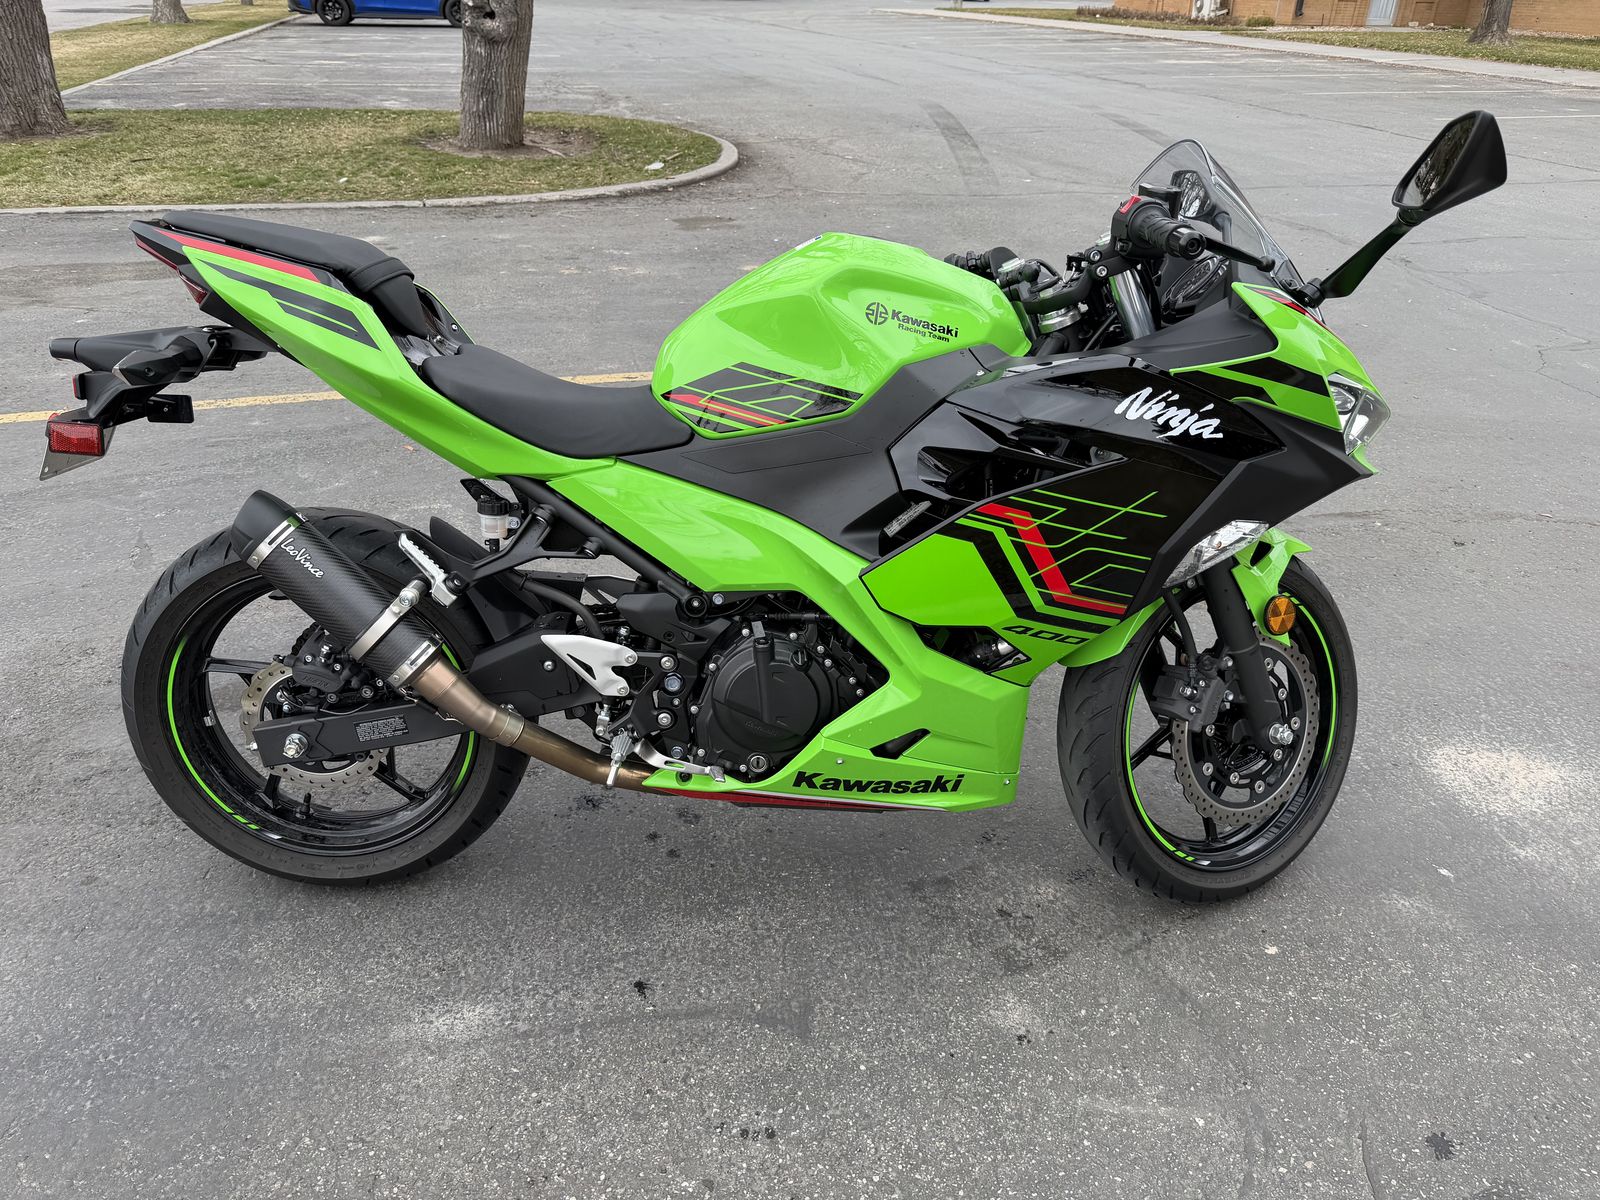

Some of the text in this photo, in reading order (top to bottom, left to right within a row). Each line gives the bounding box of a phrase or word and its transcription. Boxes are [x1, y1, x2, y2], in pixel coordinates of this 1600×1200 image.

[891, 309, 959, 338] Kawasaki
[898, 323, 950, 343] Racing Team
[1114, 386, 1224, 439] Ninja
[281, 538, 324, 578] LeoVince
[1001, 625, 1091, 645] 400
[792, 771, 965, 794] Kawasaki
